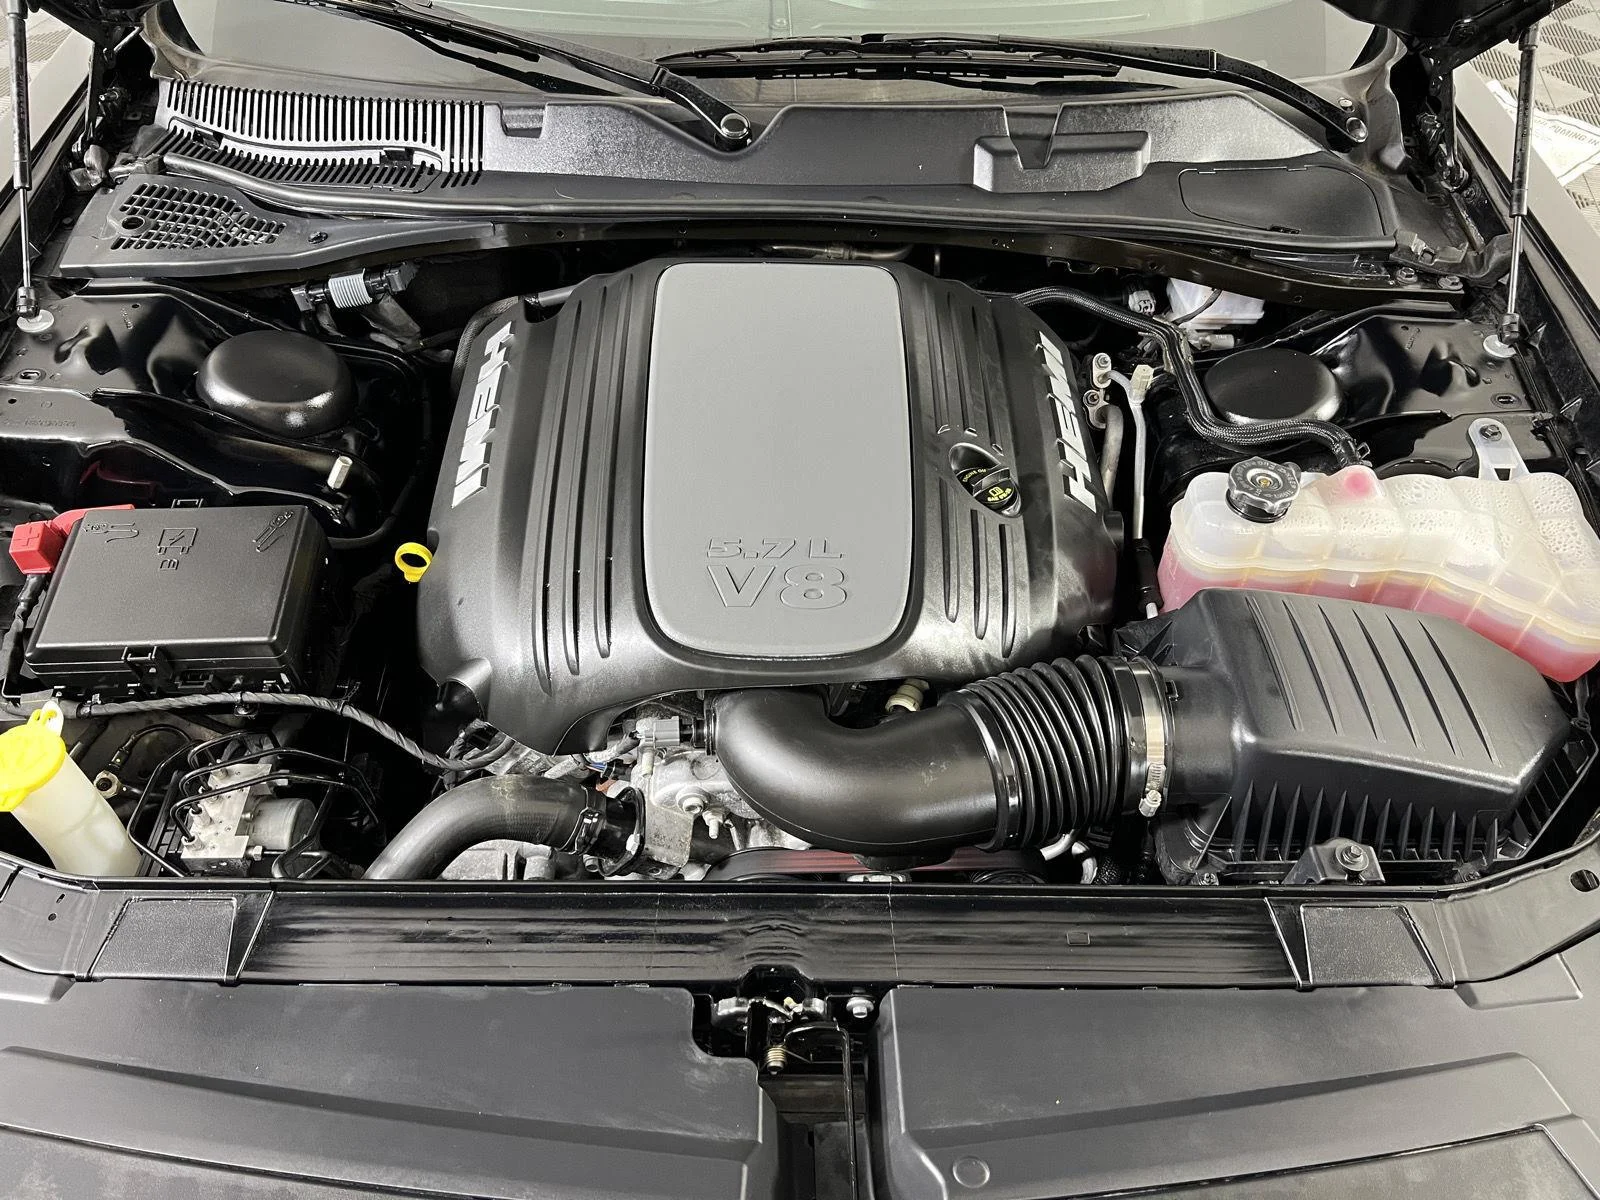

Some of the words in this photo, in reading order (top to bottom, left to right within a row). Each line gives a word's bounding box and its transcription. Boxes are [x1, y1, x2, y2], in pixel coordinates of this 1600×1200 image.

[451, 321, 513, 509] HEMI
[1038, 331, 1097, 514] HEMI
[706, 564, 848, 610] V8
